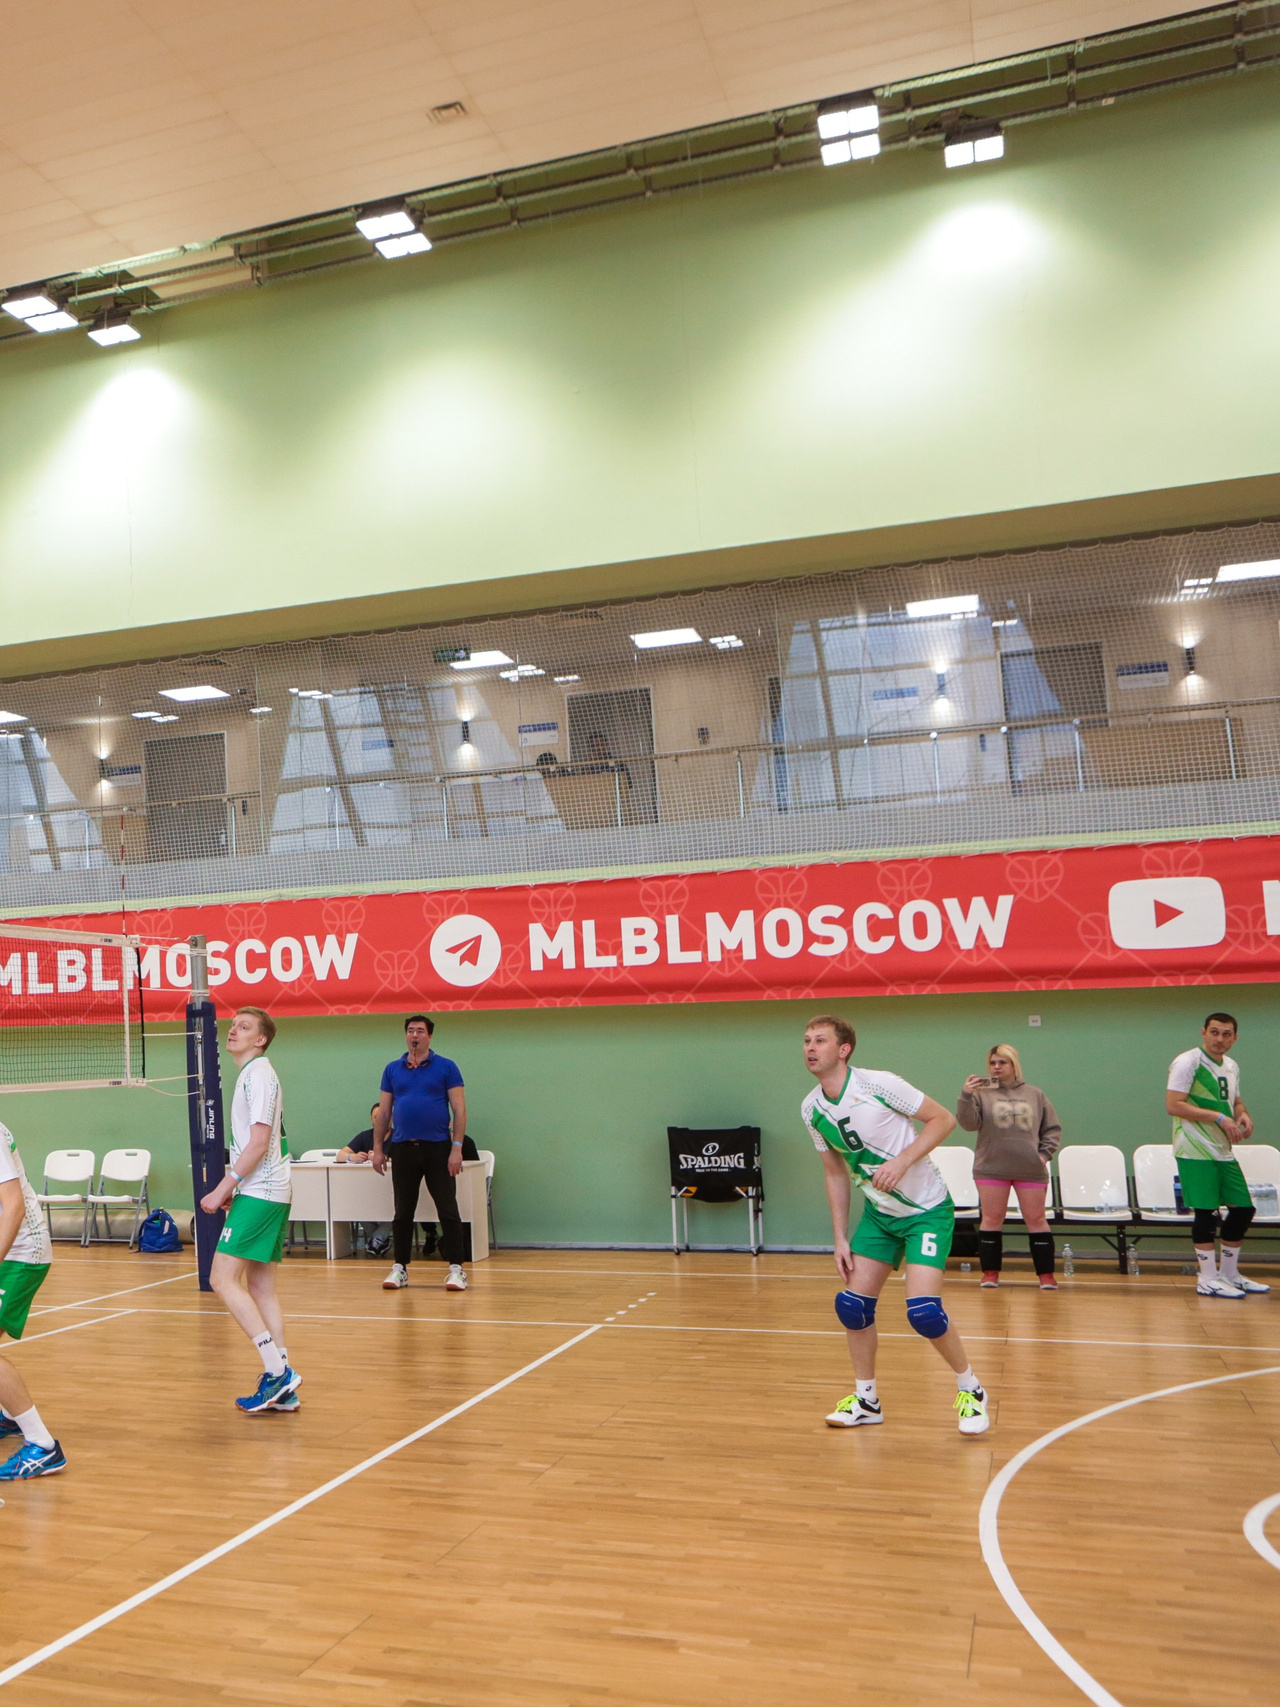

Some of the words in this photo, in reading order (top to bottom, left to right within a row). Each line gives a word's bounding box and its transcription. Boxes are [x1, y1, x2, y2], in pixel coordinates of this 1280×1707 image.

[529, 894, 1014, 972] MLBLMOSCOW
[1217, 1076, 1229, 1101] 8
[837, 1116, 864, 1152] 6
[679, 1153, 746, 1169] SPALDING
[921, 1232, 938, 1257] 6
